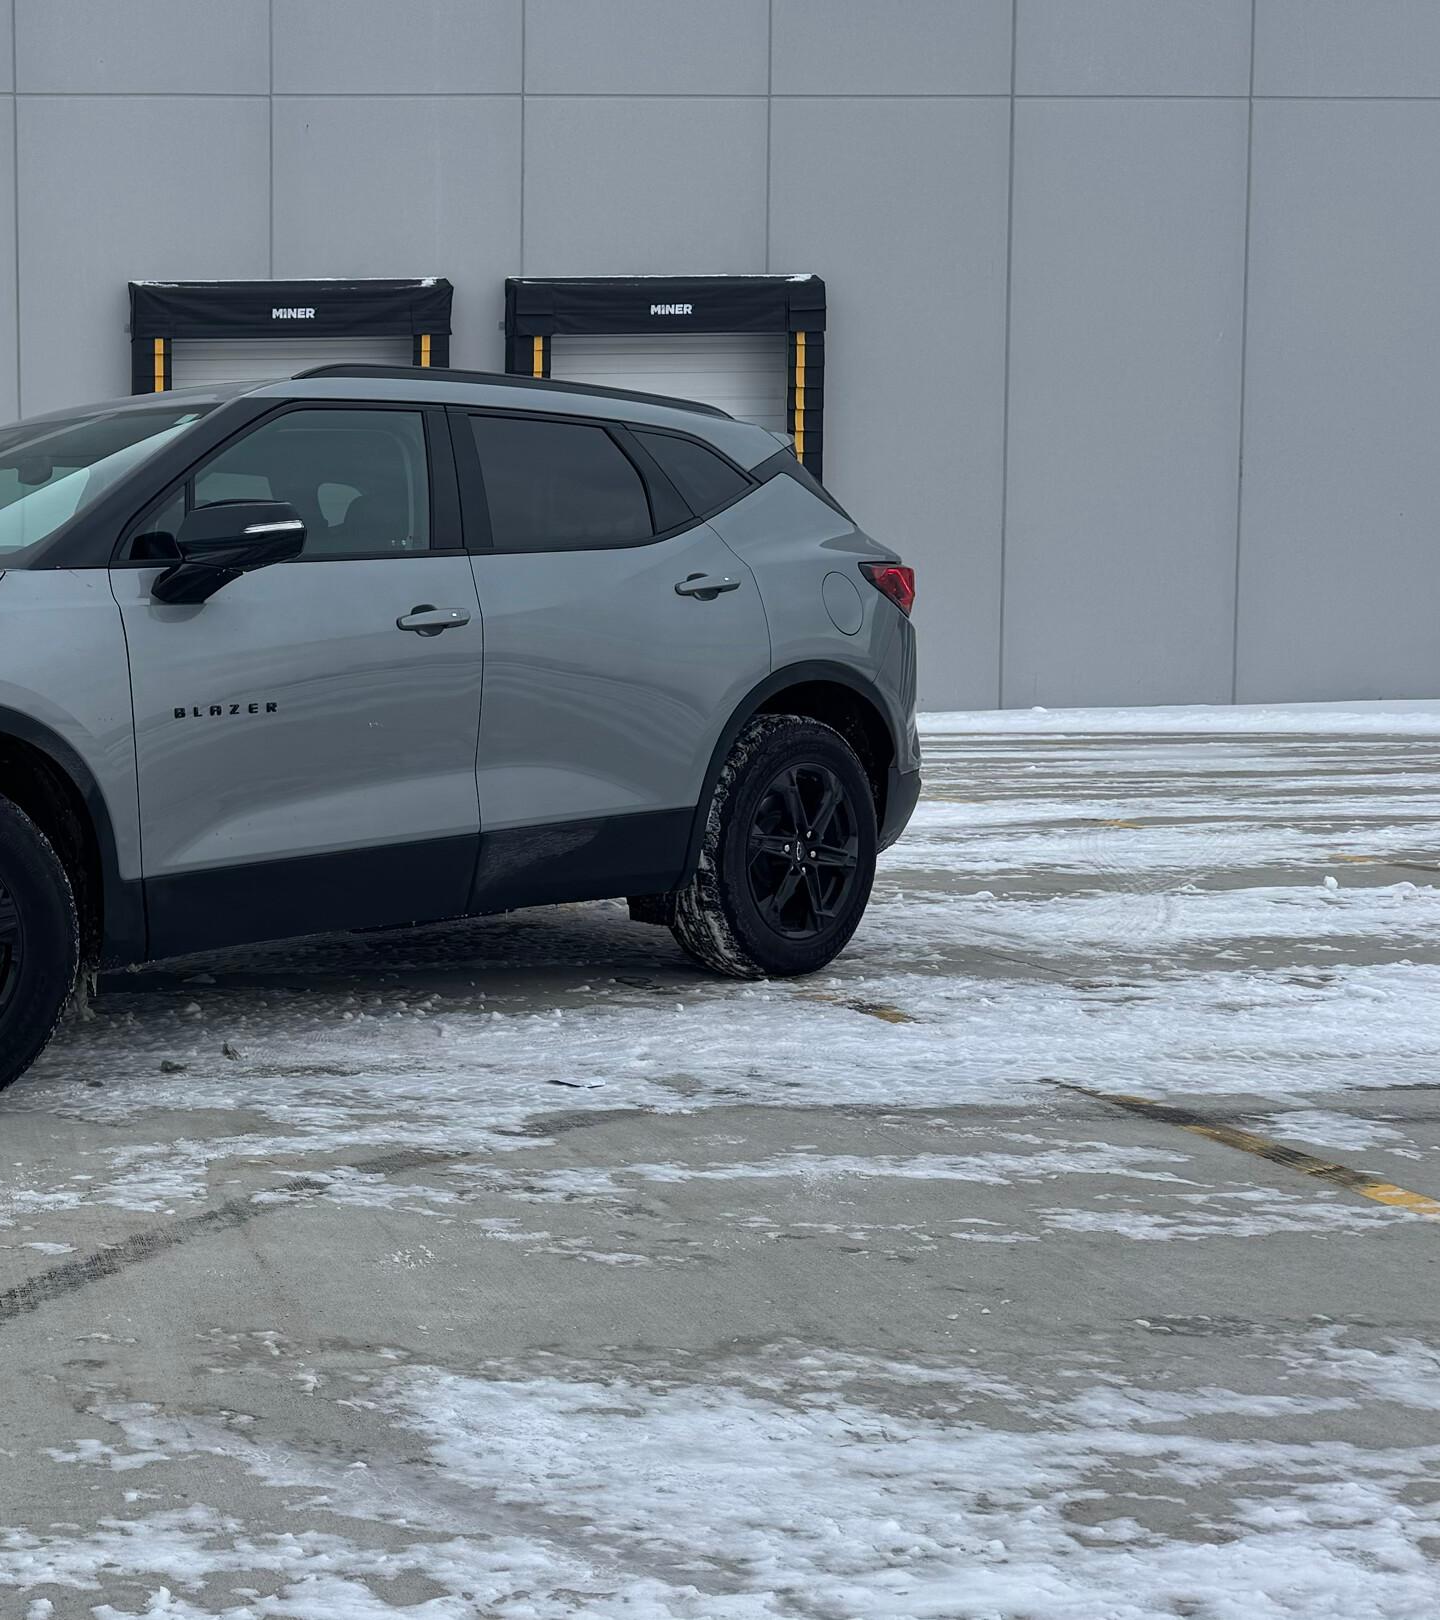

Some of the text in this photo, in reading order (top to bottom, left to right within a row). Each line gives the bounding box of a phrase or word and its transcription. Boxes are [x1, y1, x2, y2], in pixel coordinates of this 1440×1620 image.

[271, 308, 316, 319] MINER
[650, 304, 693, 315] MINER
[174, 702, 278, 719] BLAZER
